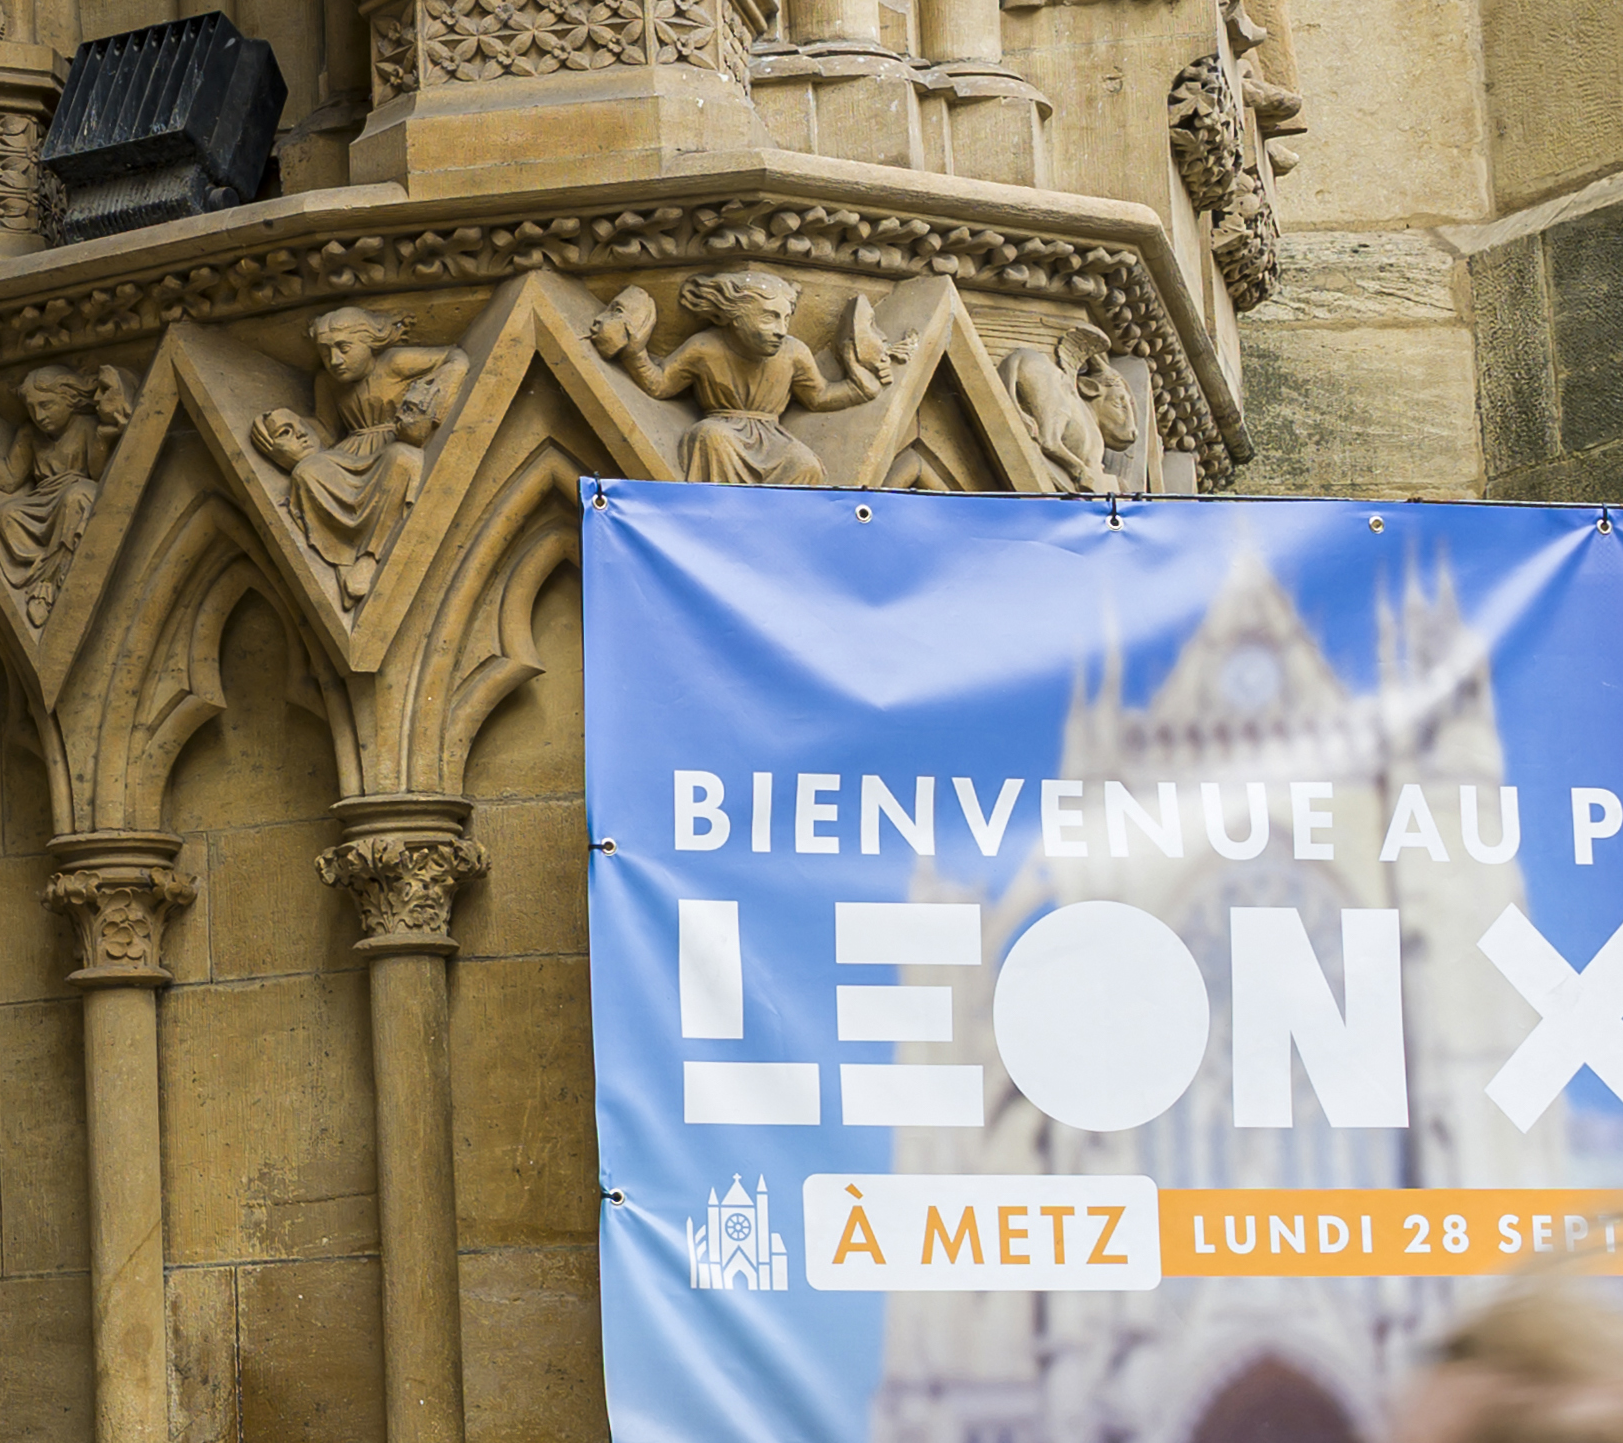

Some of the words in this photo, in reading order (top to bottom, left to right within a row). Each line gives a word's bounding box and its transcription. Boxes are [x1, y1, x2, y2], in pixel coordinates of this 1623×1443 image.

[673, 769, 1335, 861] BIENVENUE
[1378, 783, 1522, 866] AU
[677, 898, 1410, 1132] LEON
[831, 1182, 888, 1265] À
[920, 1205, 1129, 1265] METZ
[1193, 1213, 1374, 1254] LUNDI
[1403, 1213, 1471, 1255] 28
